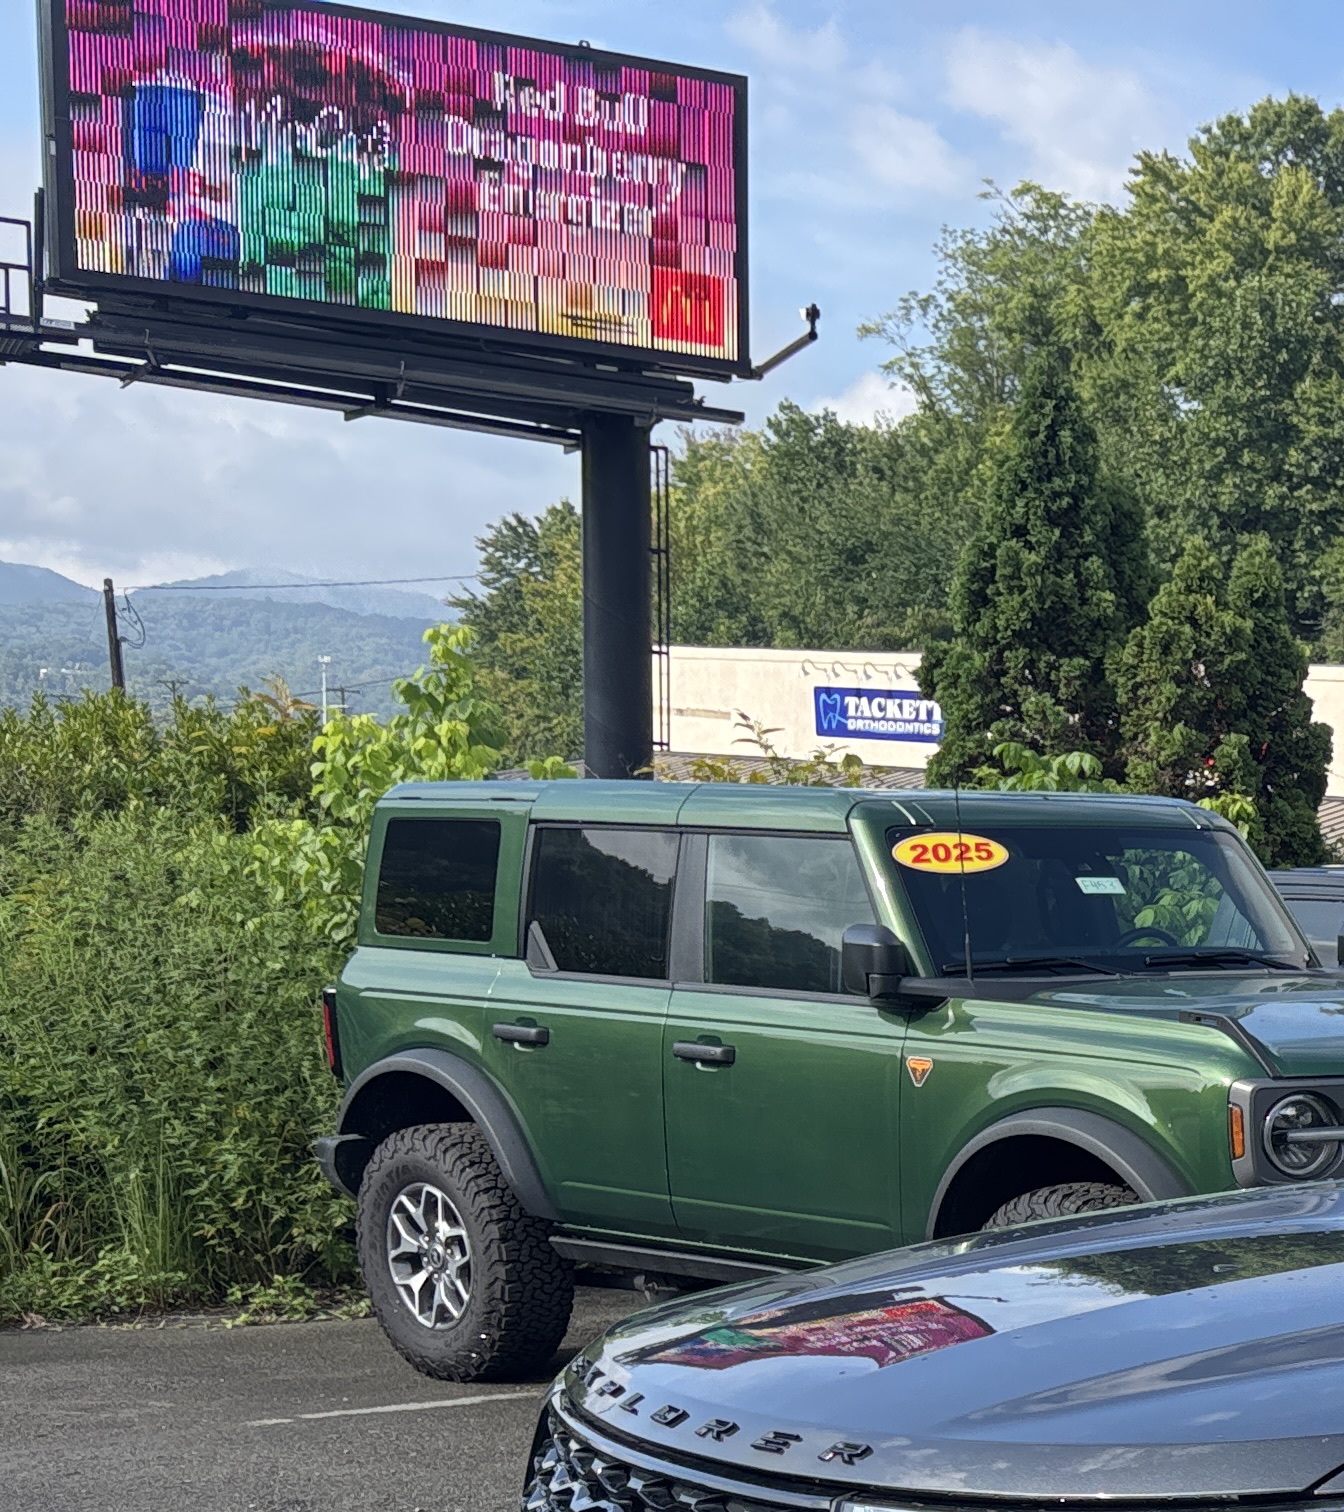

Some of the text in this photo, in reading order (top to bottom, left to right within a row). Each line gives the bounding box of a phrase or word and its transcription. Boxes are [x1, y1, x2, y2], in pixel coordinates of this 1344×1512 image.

[493, 71, 649, 136] Red Bull
[444, 114, 687, 212] Dragonberry
[478, 168, 658, 236] Energizer
[844, 696, 942, 721] TACKETT
[847, 718, 940, 735] ORTHODONTICS
[909, 842, 994, 864] 2025
